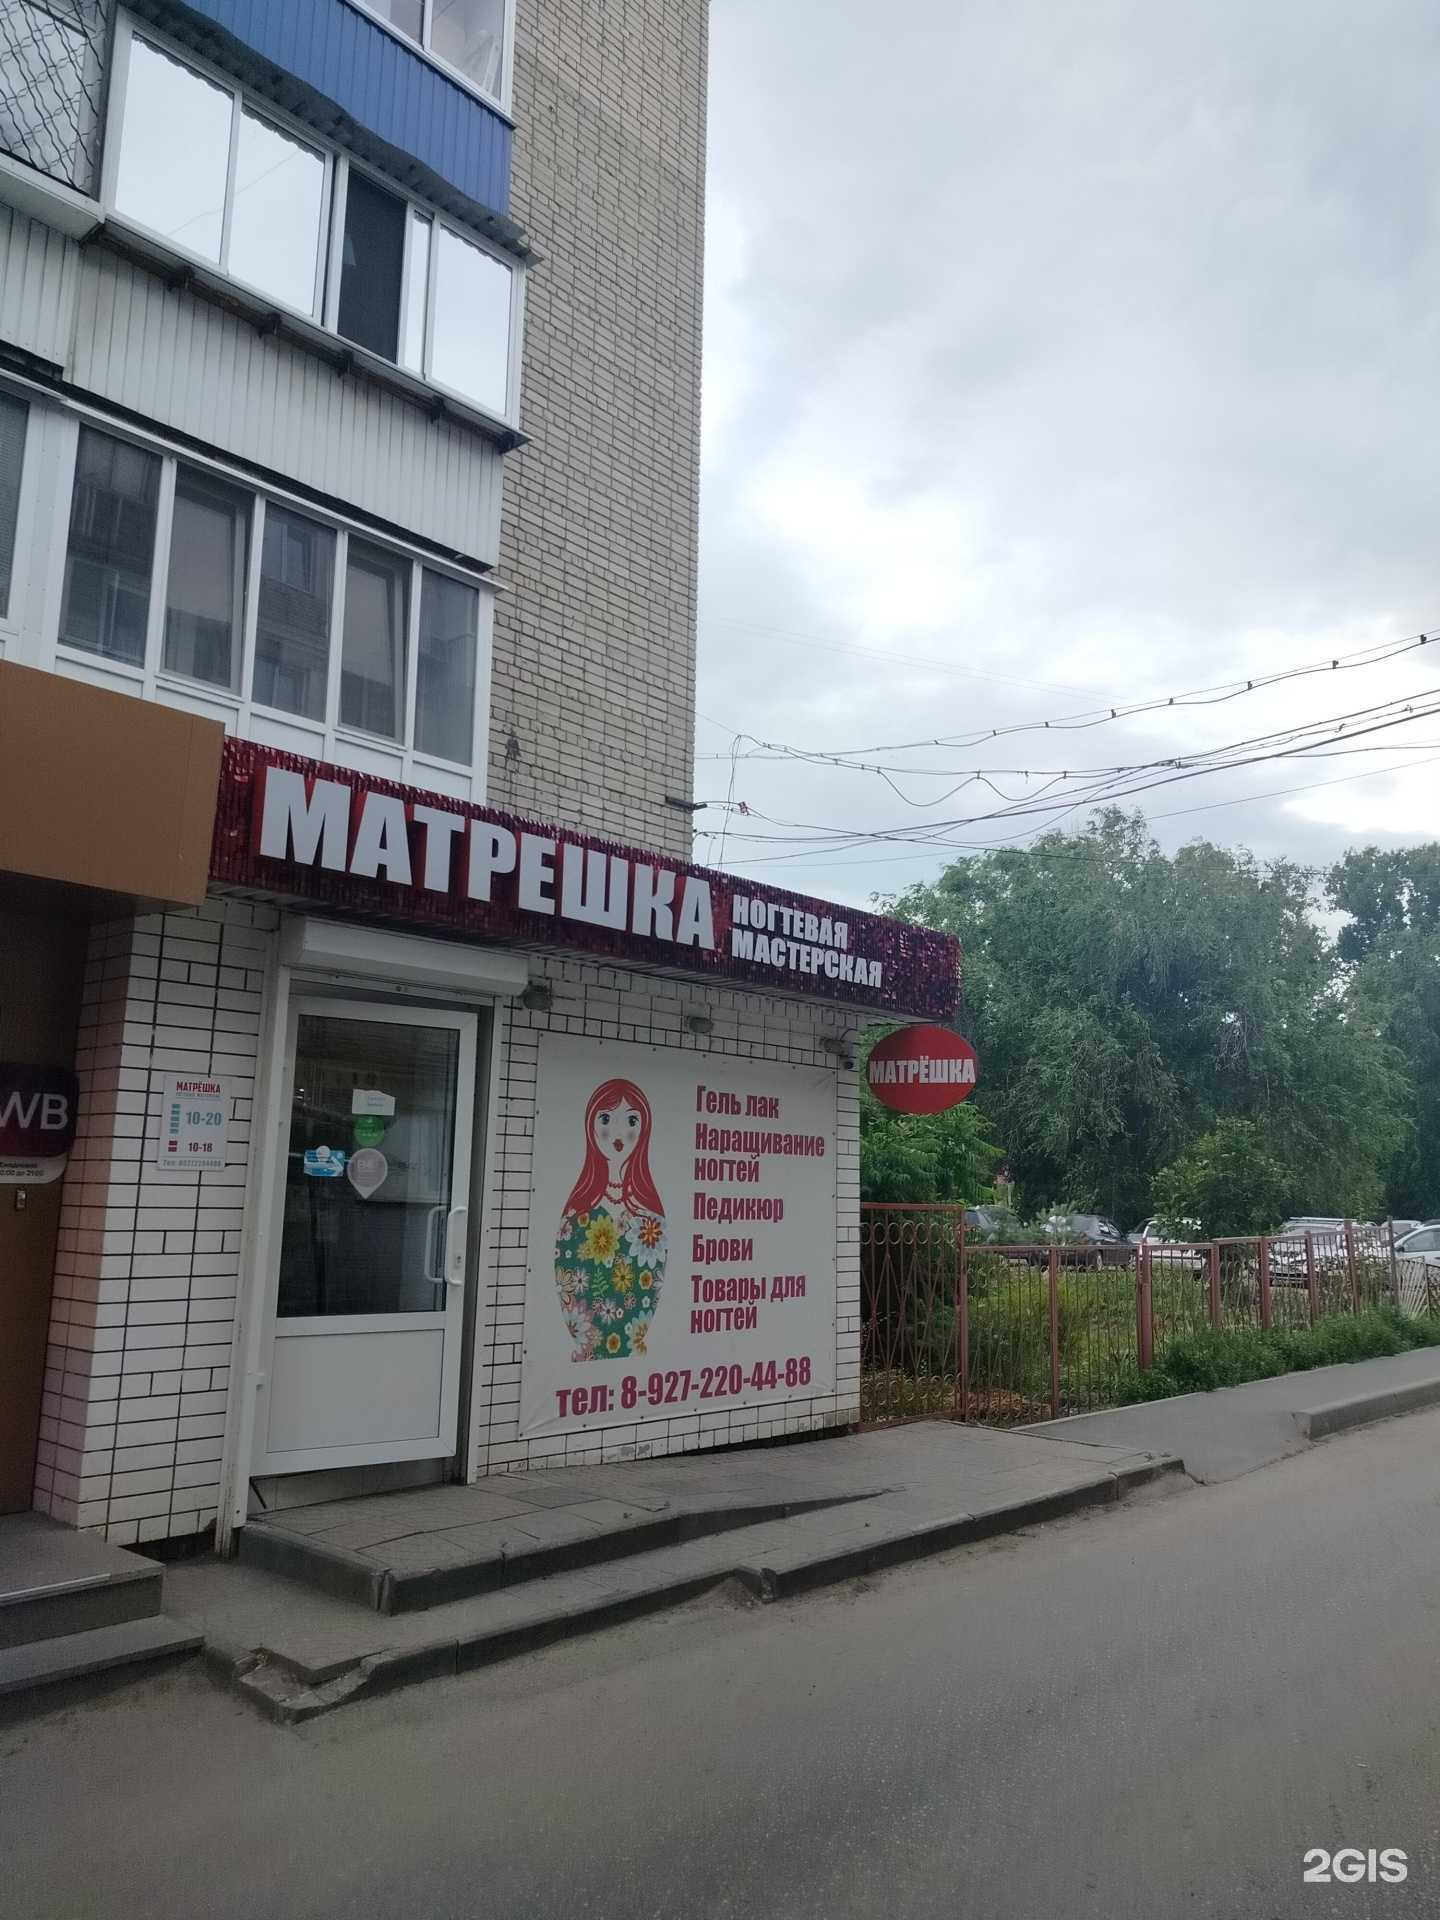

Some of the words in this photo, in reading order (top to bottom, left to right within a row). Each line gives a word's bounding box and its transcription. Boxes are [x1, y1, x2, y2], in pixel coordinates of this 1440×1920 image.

[259, 765, 717, 951] МАТРЕШКА
[732, 894, 849, 950] НОГТЕВАЯ
[731, 927, 882, 988] МАСТЕРСКАЯ
[869, 1055, 976, 1084] МАТРЁШКА
[186, 1110, 222, 1126] 10-20
[696, 1085, 742, 1116] Гель
[745, 1096, 779, 1119] лак
[694, 1123, 826, 1157] Наращивание
[694, 1153, 760, 1182] ногтей
[693, 1192, 784, 1224] Педикюр
[692, 1234, 753, 1264] Брови
[691, 1275, 766, 1303] Товары
[770, 1274, 806, 1299] для
[690, 1302, 757, 1334] ногтей
[556, 1384, 614, 1418] тел:
[621, 1356, 812, 1409] 8-927-220-44-88
